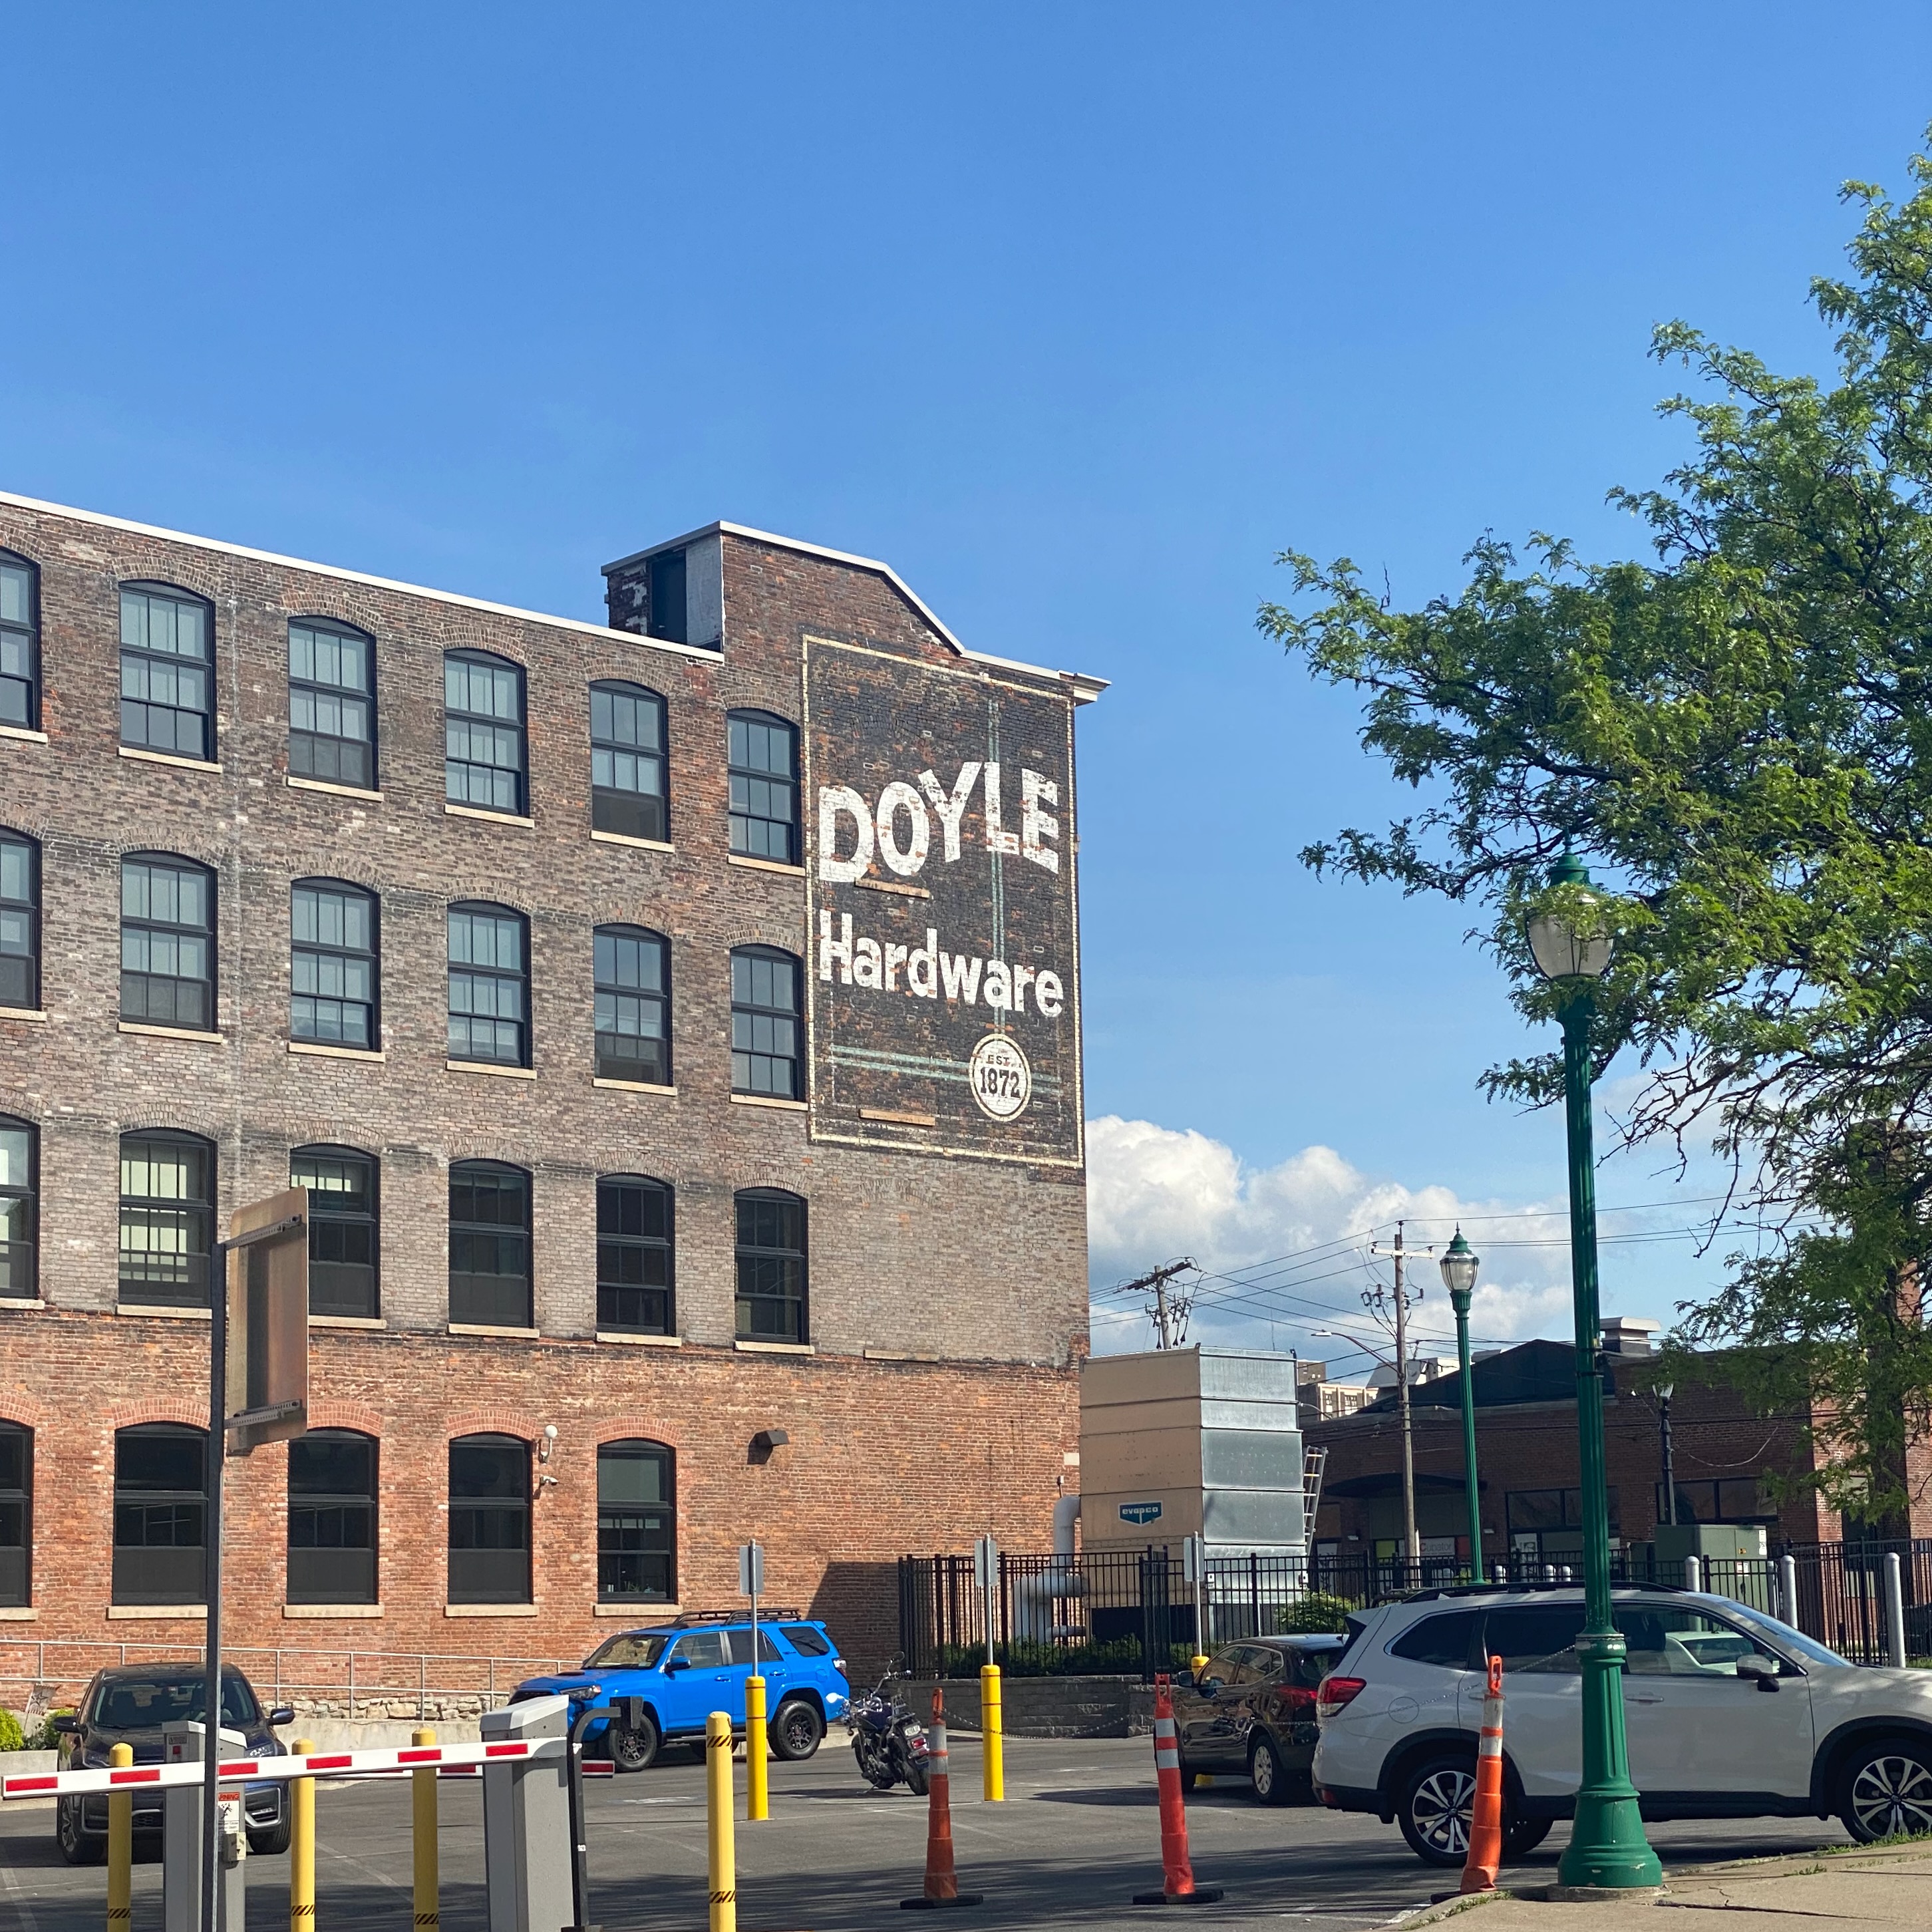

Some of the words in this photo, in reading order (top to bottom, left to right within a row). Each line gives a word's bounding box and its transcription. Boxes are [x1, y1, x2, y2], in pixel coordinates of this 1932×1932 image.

[819, 761, 1058, 883] DOYLE
[820, 909, 1063, 1017] Hardware
[980, 1066, 1021, 1099] 1872
[1122, 1506, 1159, 1518] evapco
